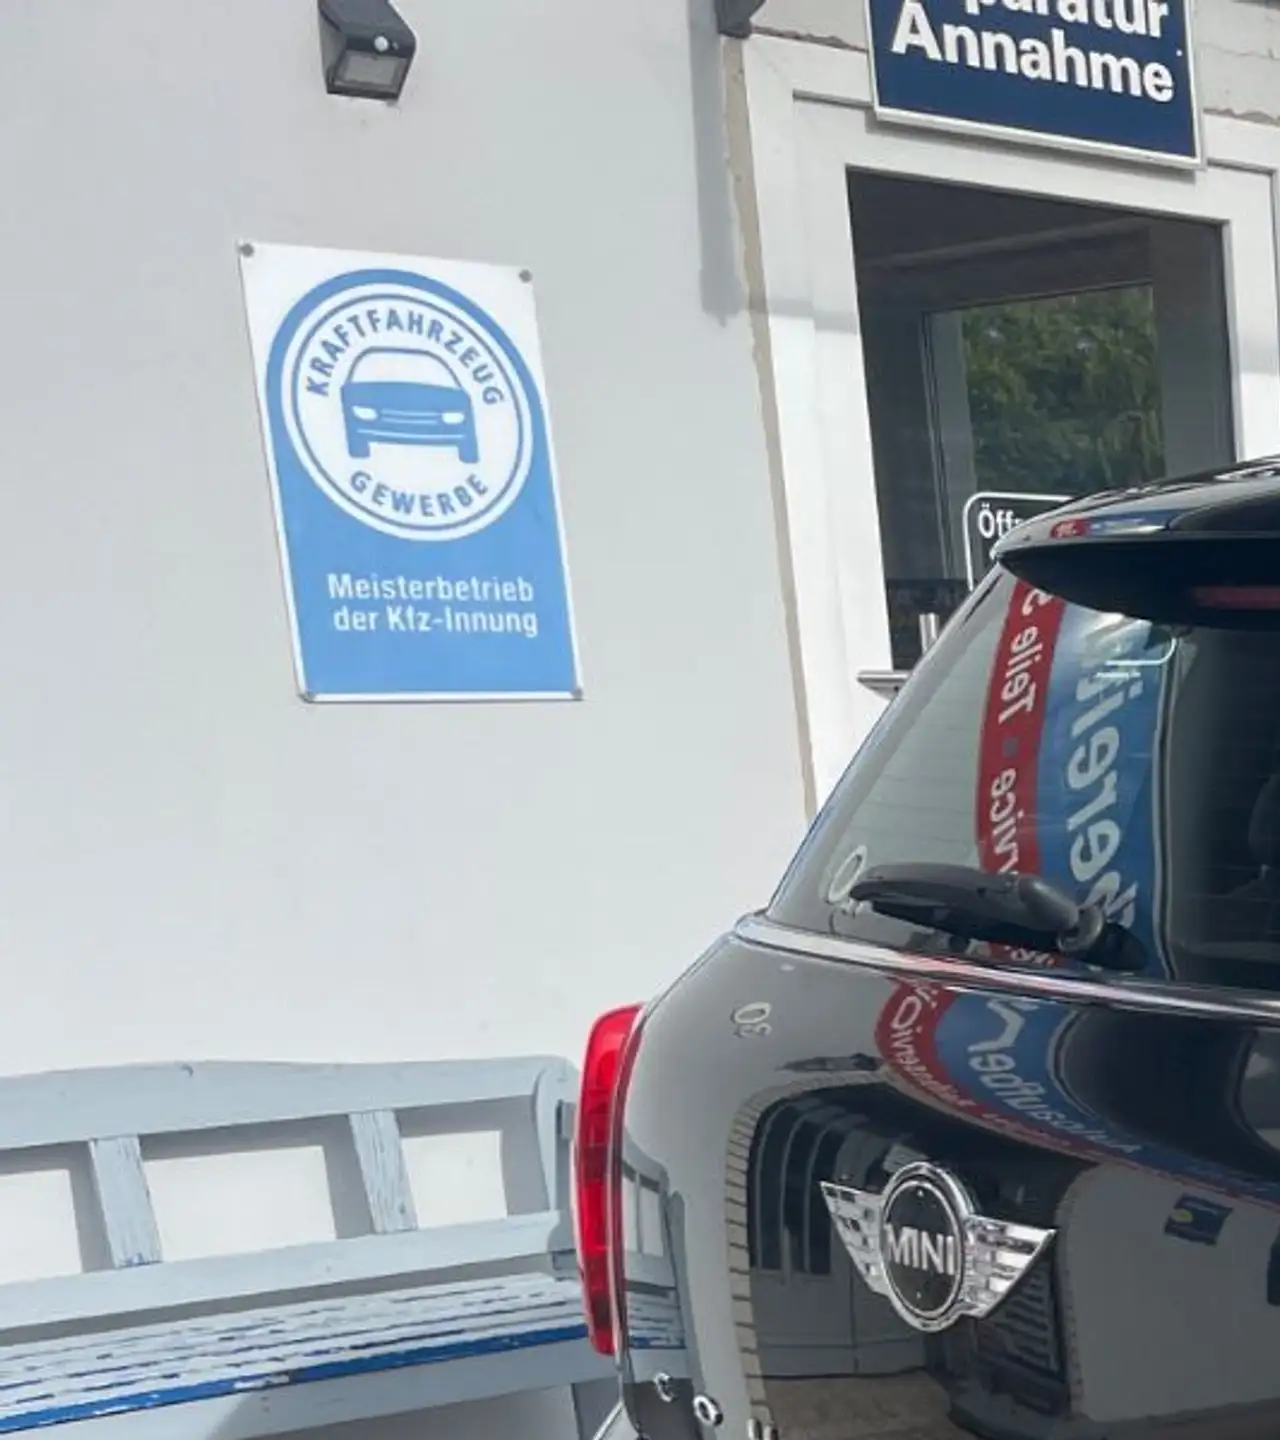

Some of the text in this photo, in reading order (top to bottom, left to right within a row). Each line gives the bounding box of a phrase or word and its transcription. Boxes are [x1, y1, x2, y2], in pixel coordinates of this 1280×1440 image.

[890, 2, 1174, 102] Annahme
[306, 308, 505, 406] KRAFTFAHRZEUG
[349, 469, 489, 519] GEWERBE
[327, 572, 534, 602] Meisterbetrieb
[333, 605, 539, 638] der Kfz-Innung
[883, 1223, 956, 1276] MINI
